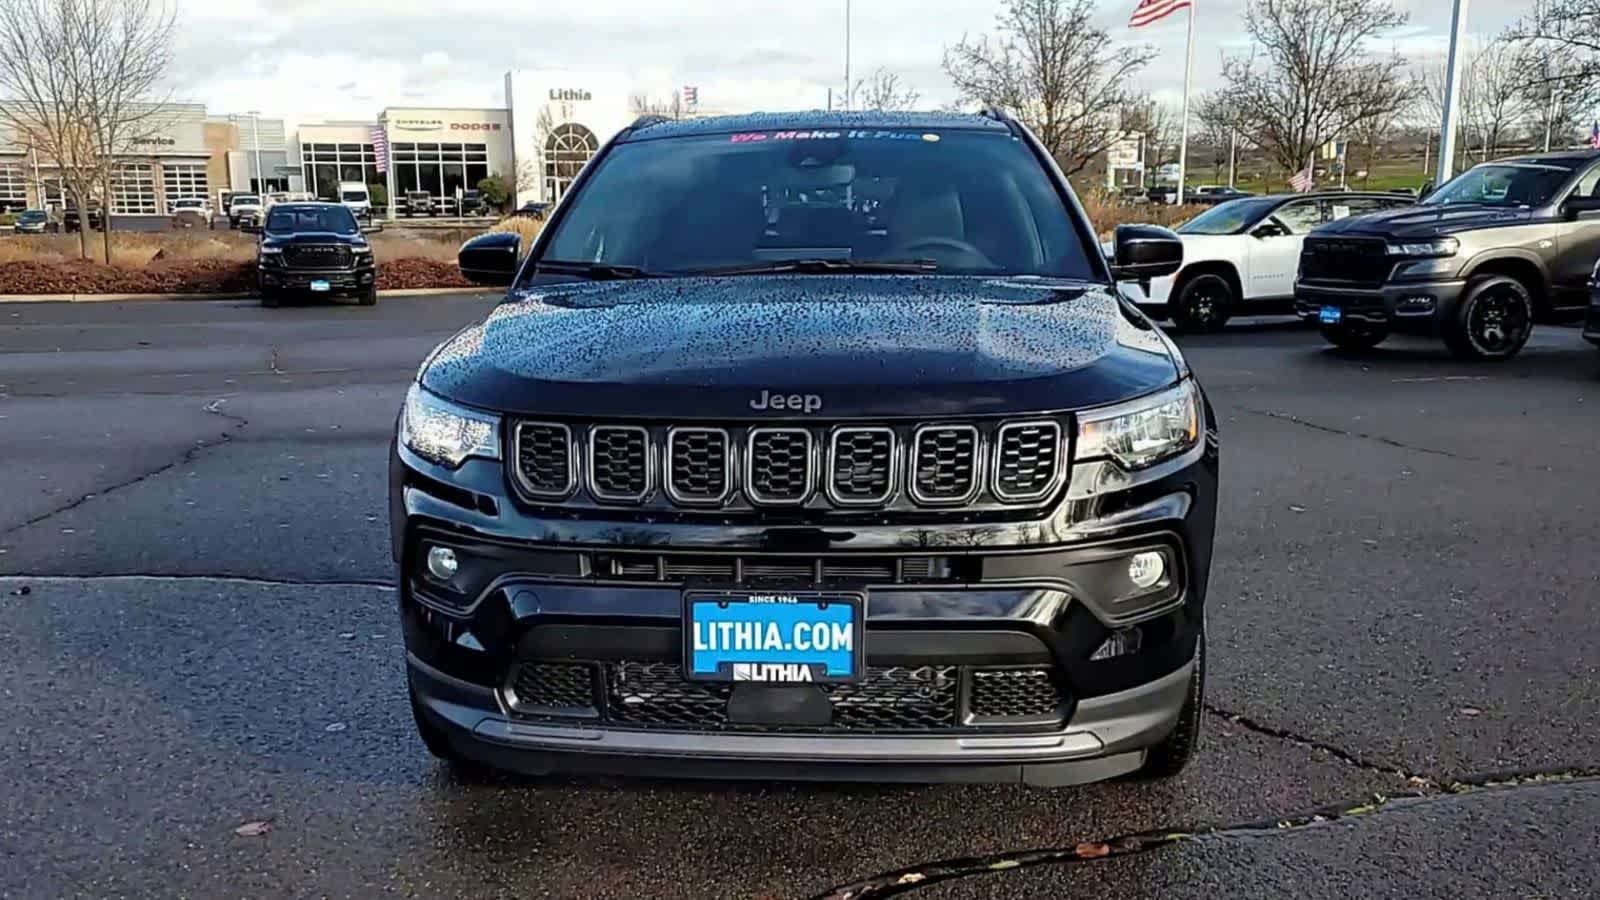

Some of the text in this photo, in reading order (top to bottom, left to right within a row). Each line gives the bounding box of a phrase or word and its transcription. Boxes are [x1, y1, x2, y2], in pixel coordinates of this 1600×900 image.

[549, 88, 592, 101] Lithia
[450, 122, 501, 131] DODGE
[731, 132, 767, 143] We
[774, 130, 841, 140] Make
[749, 389, 822, 413] Jeep
[749, 595, 776, 605] SINCE
[693, 621, 854, 651] LITHIA.COM
[751, 663, 813, 682] LITHIA
